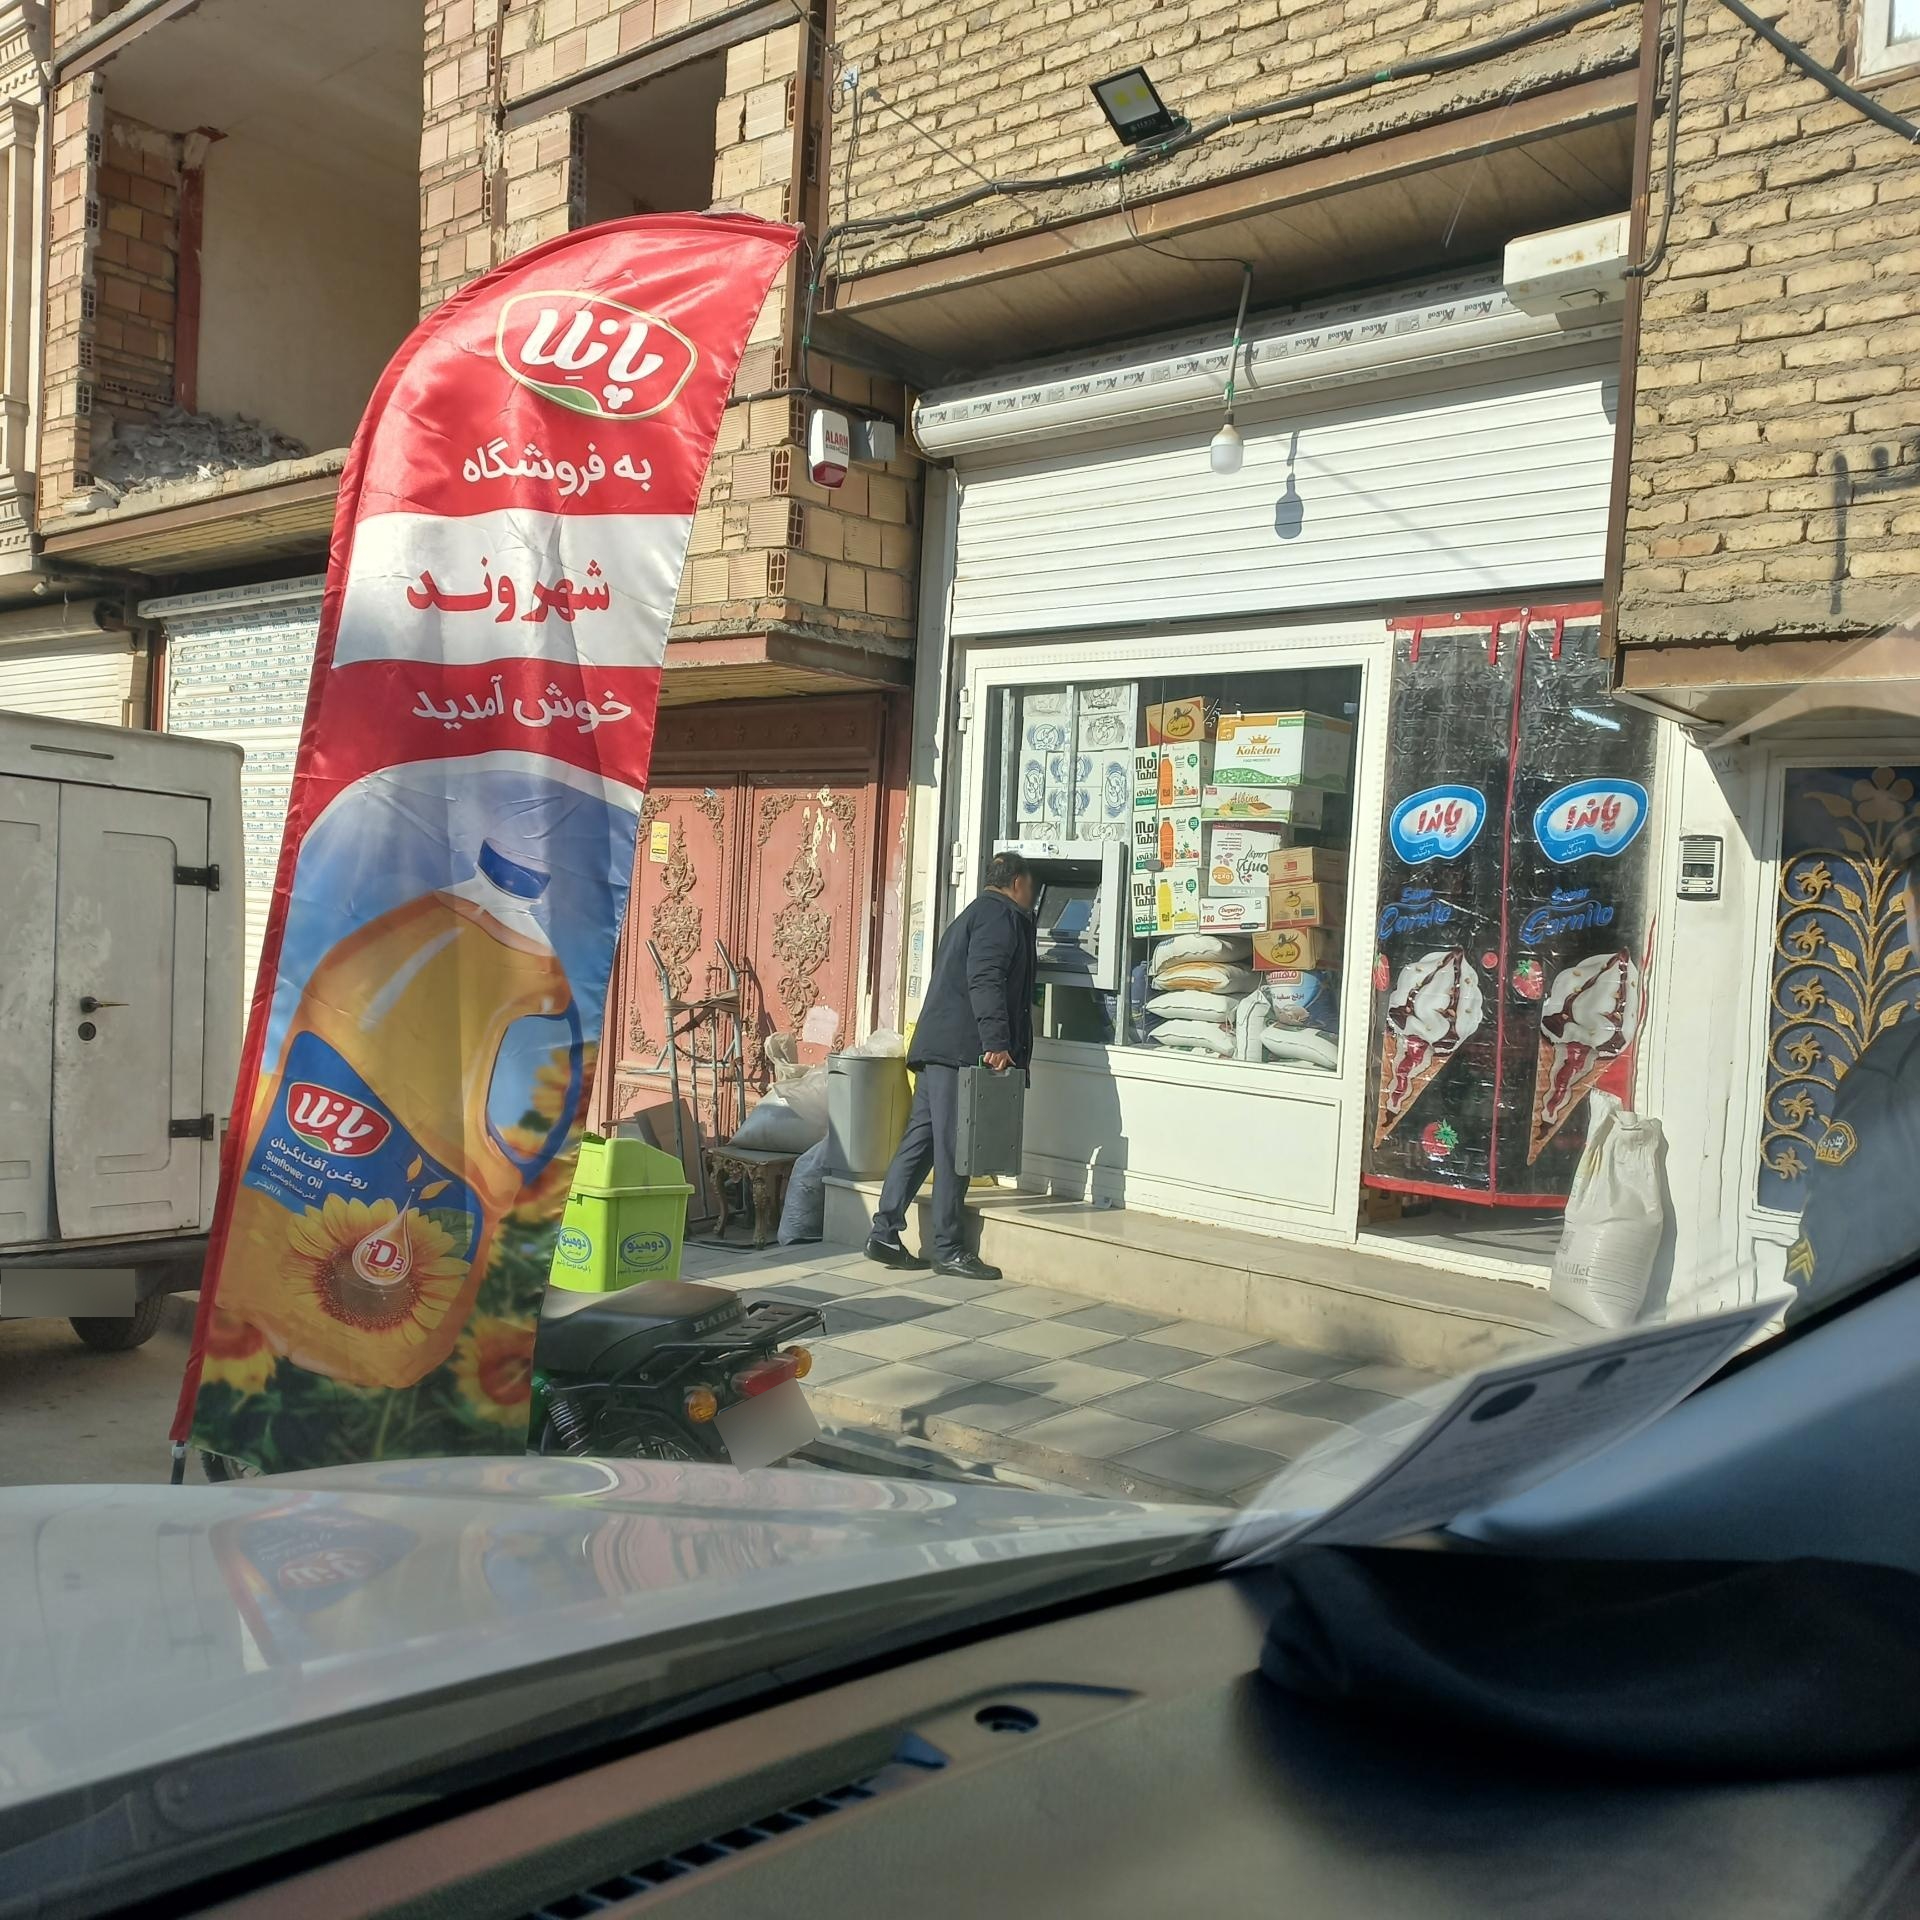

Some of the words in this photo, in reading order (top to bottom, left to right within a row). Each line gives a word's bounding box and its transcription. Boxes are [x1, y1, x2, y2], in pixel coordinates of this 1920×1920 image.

[825, 429, 848, 446] ALARM
[462, 436, 605, 497] فروشگاه
[614, 451, 652, 492] به
[405, 555, 611, 623] شهروند
[411, 672, 504, 731] آمدید
[513, 681, 632, 734] خوش
[1416, 799, 1462, 838] پاندا
[1565, 794, 1621, 834] پاندا
[265, 1150, 305, 1180] Sunflower
[307, 1175, 323, 1190] Oil
[270, 1138, 328, 1172] آفتابگردان
[326, 1168, 368, 1190] روغن
[561, 1233, 587, 1250] دومینو
[627, 1240, 665, 1254] دومینو
